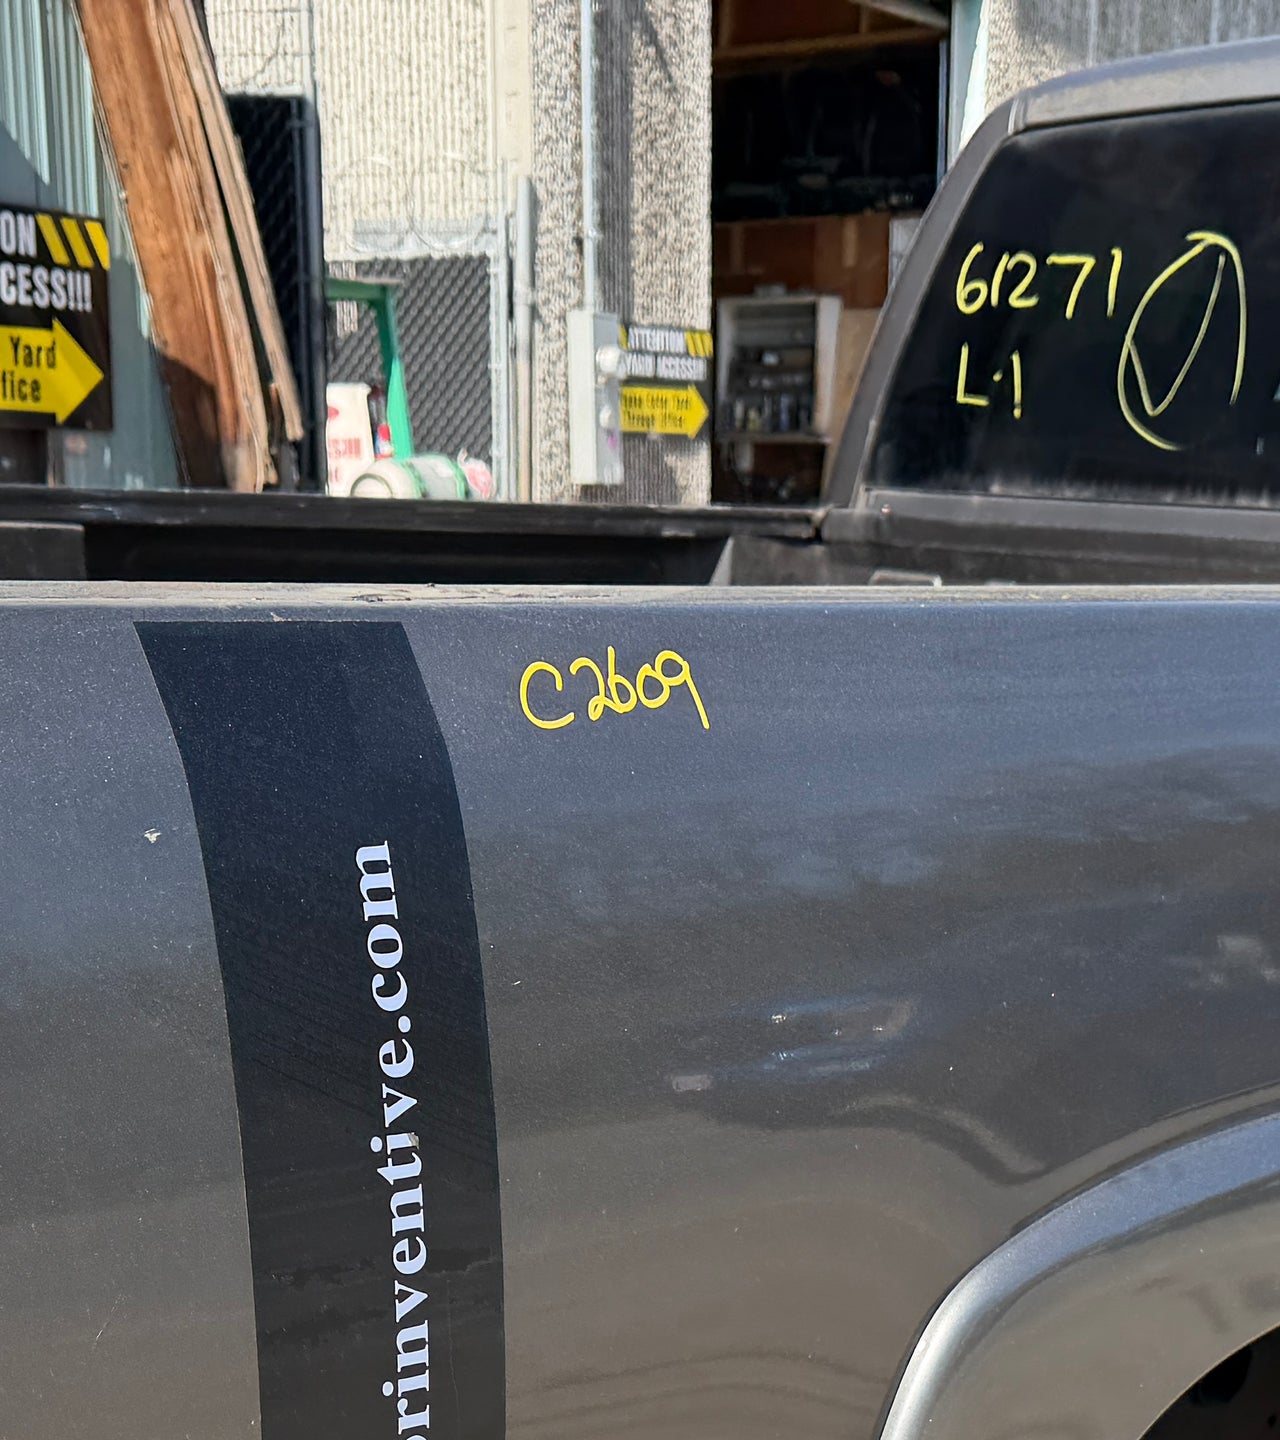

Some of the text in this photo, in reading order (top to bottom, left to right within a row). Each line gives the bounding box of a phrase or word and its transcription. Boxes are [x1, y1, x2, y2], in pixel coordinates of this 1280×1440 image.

[956, 241, 1122, 320] 61271
[9, 336, 57, 369] Yard
[520, 645, 710, 730] C2609
